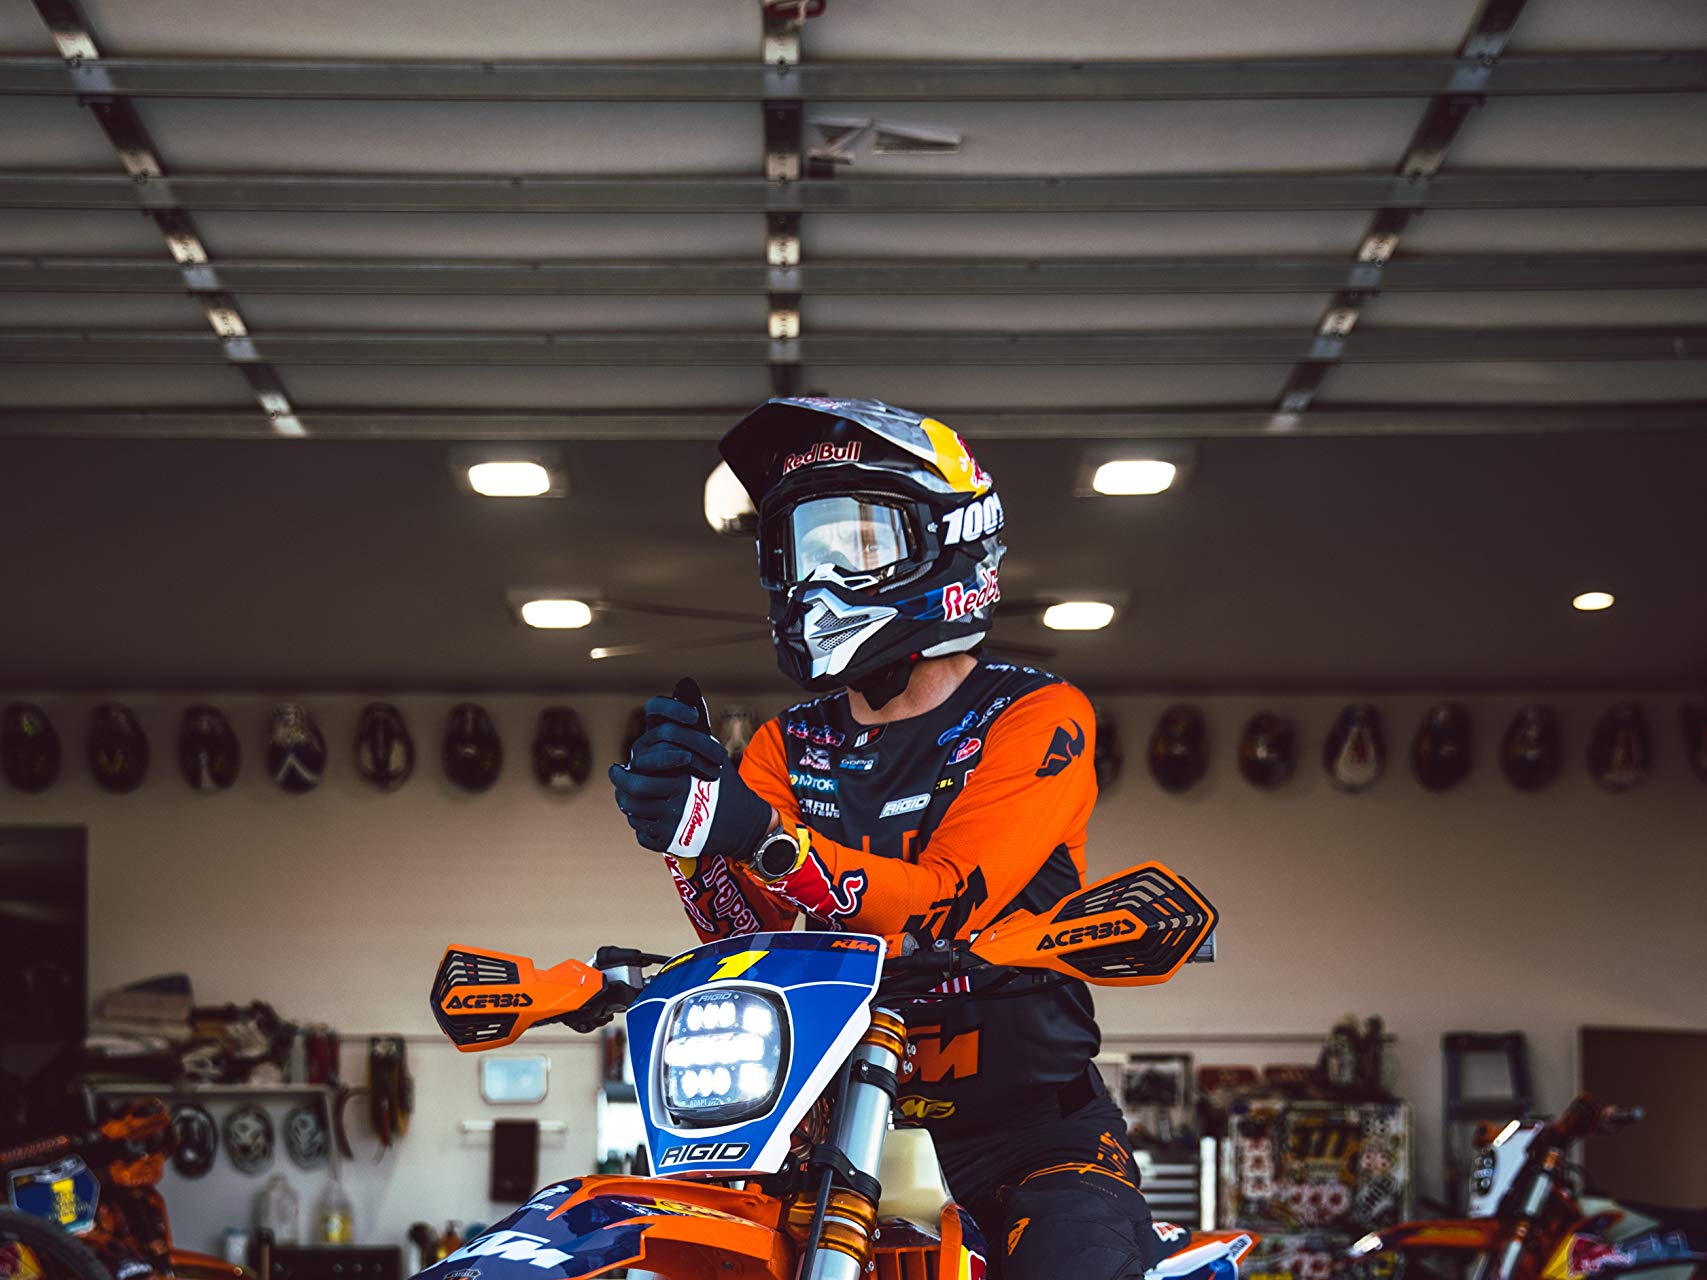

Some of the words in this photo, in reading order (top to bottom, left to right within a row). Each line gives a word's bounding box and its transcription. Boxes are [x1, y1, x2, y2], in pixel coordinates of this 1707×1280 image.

[783, 444, 818, 476] Red
[817, 441, 861, 462] Bull
[840, 758, 874, 767] GoPro
[881, 795, 930, 818] RIGID
[702, 854, 739, 912] Bull
[831, 939, 877, 952] KTM
[707, 950, 770, 981] 1
[699, 992, 732, 1002] RIGID
[660, 1143, 750, 1166] RIGID
